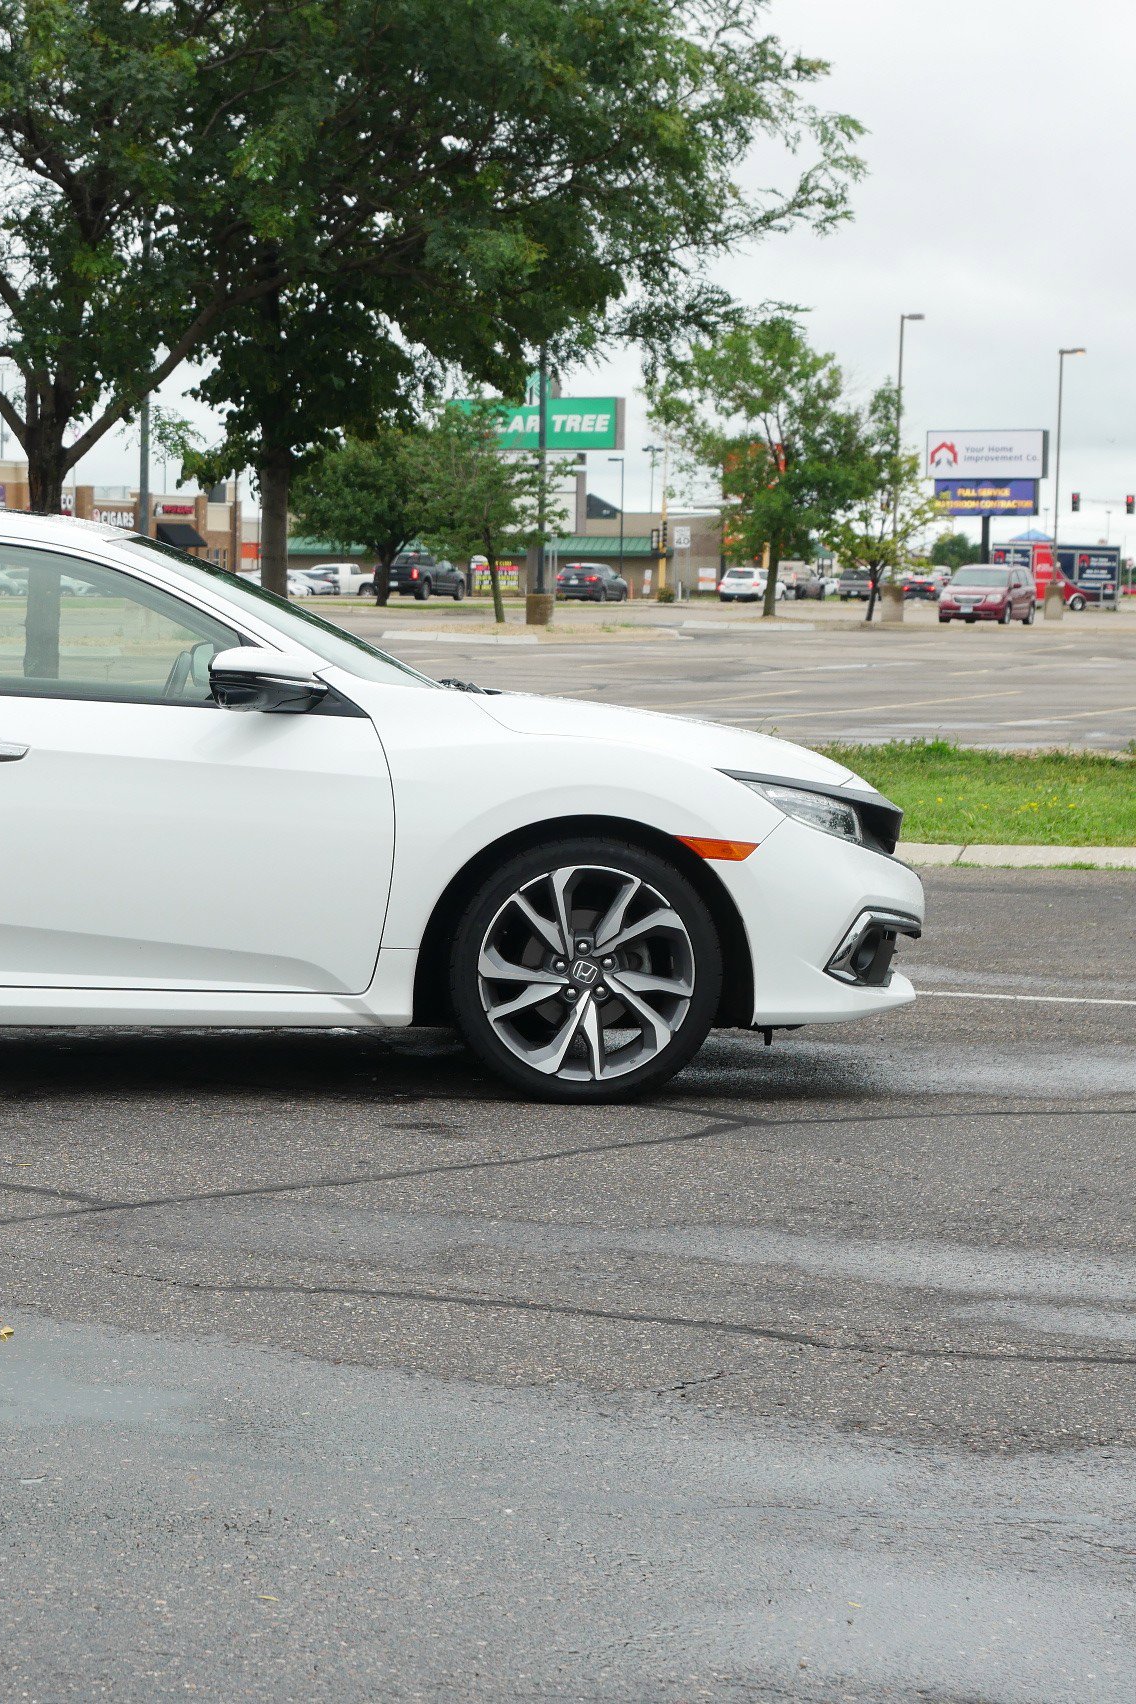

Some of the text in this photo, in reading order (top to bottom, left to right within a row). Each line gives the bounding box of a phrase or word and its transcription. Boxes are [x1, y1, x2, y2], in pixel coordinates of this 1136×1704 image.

[552, 414, 611, 433] TREE
[964, 446, 1014, 454] Your Home
[963, 454, 1023, 463] Improvement
[101, 510, 135, 528] CIGARS
